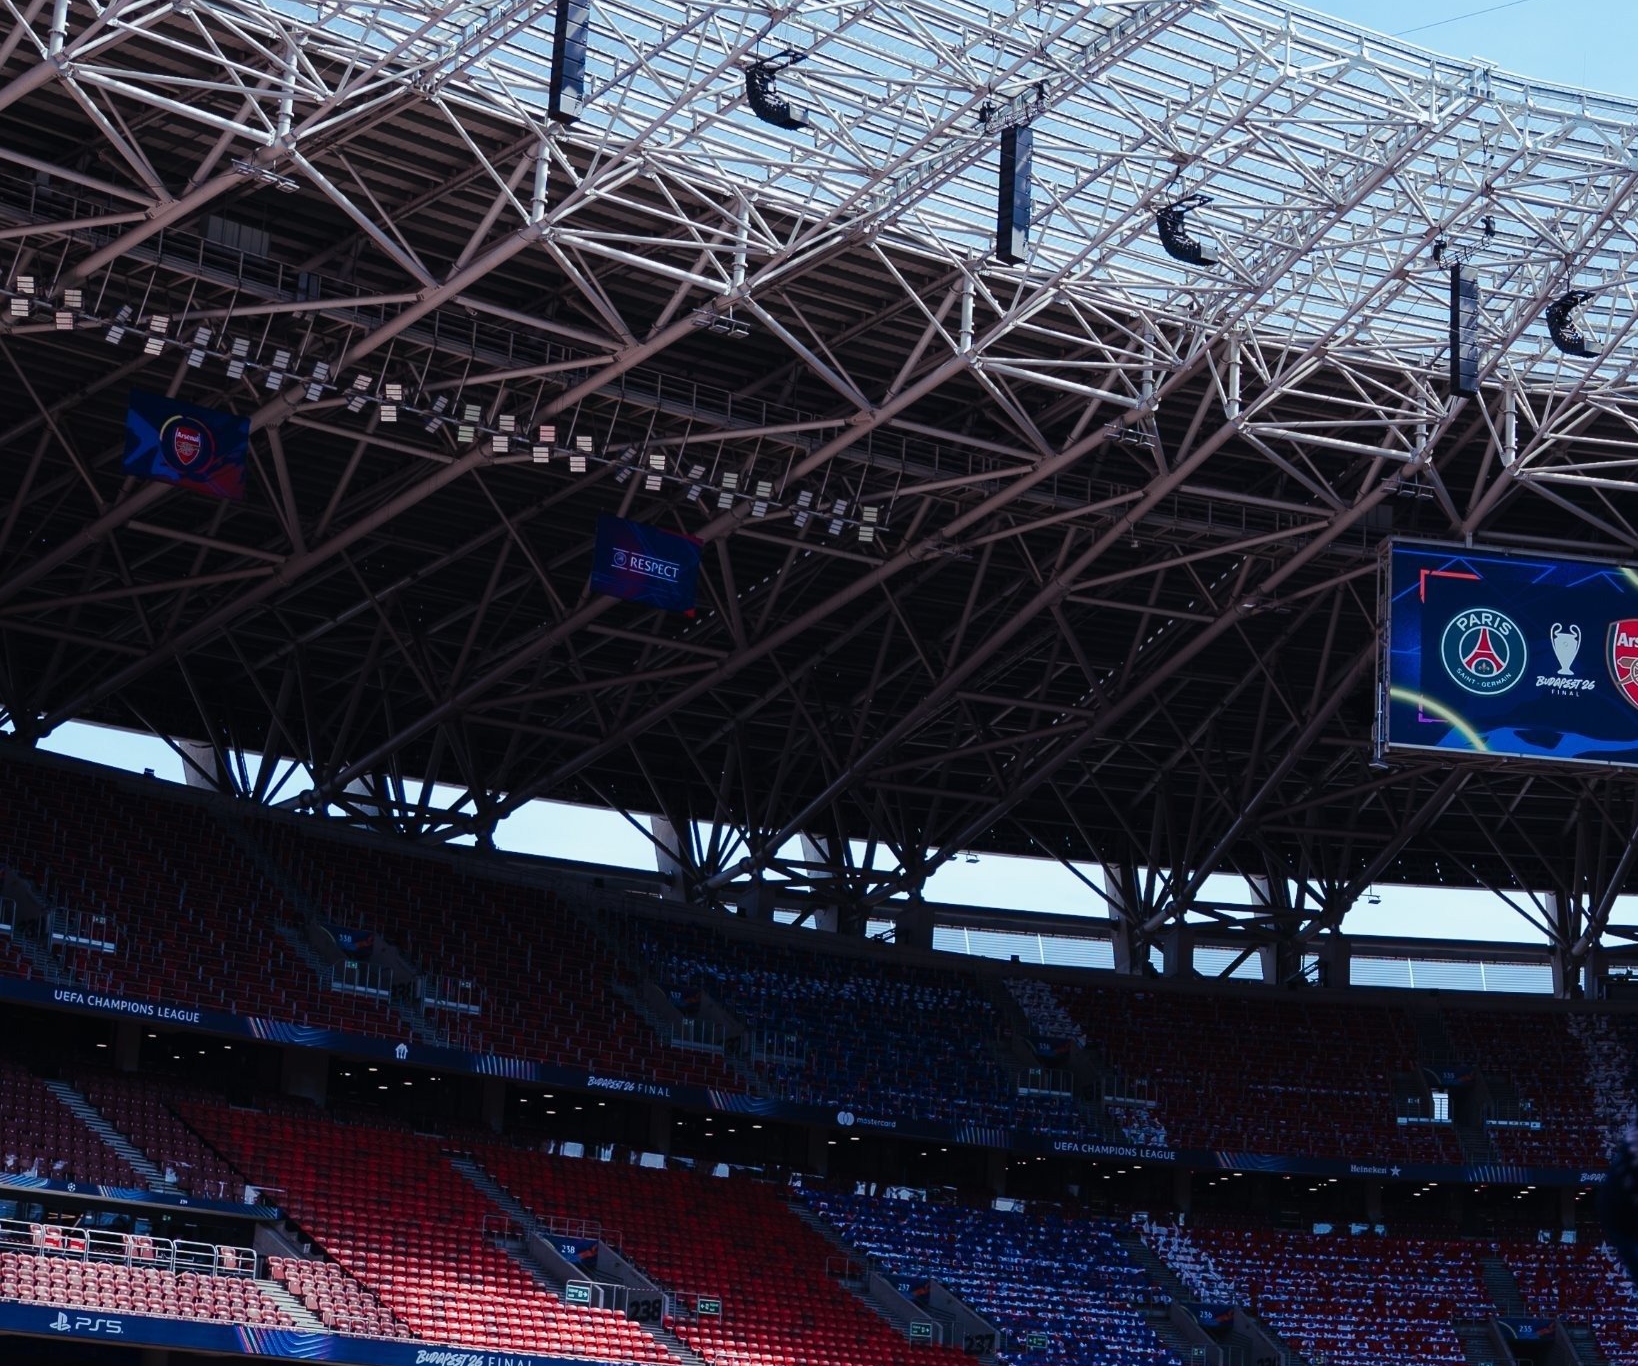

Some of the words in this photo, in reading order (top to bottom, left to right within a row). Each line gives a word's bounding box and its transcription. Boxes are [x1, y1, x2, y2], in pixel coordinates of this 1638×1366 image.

[177, 431, 201, 443] Arsenal
[630, 556, 680, 578] RESPECT
[1456, 613, 1512, 636] PARIS
[1456, 667, 1476, 685] SAINT
[1481, 672, 1512, 687] GERMAIN
[1535, 676, 1582, 690] BUDAPEST
[1581, 679, 1596, 690] 26
[1551, 689, 1580, 698] FINAL
[54, 989, 85, 1005] UEFA
[87, 995, 154, 1016] CHAMPIONS
[157, 1007, 200, 1023] LEAGUE
[637, 1083, 671, 1097] FINAL
[857, 1116, 896, 1128] mastercard
[1054, 1141, 1079, 1152] UEFA
[1081, 1144, 1137, 1157] CHAMPIONS
[1140, 1149, 1176, 1160] LEAGUE
[1350, 1164, 1387, 1175] Heineken
[561, 1244, 575, 1254] 238
[898, 1283, 910, 1292] 237
[630, 1299, 662, 1322] 238
[1199, 1310, 1213, 1319] 236
[75, 1316, 122, 1334] PS5
[1519, 1325, 1533, 1333] 235
